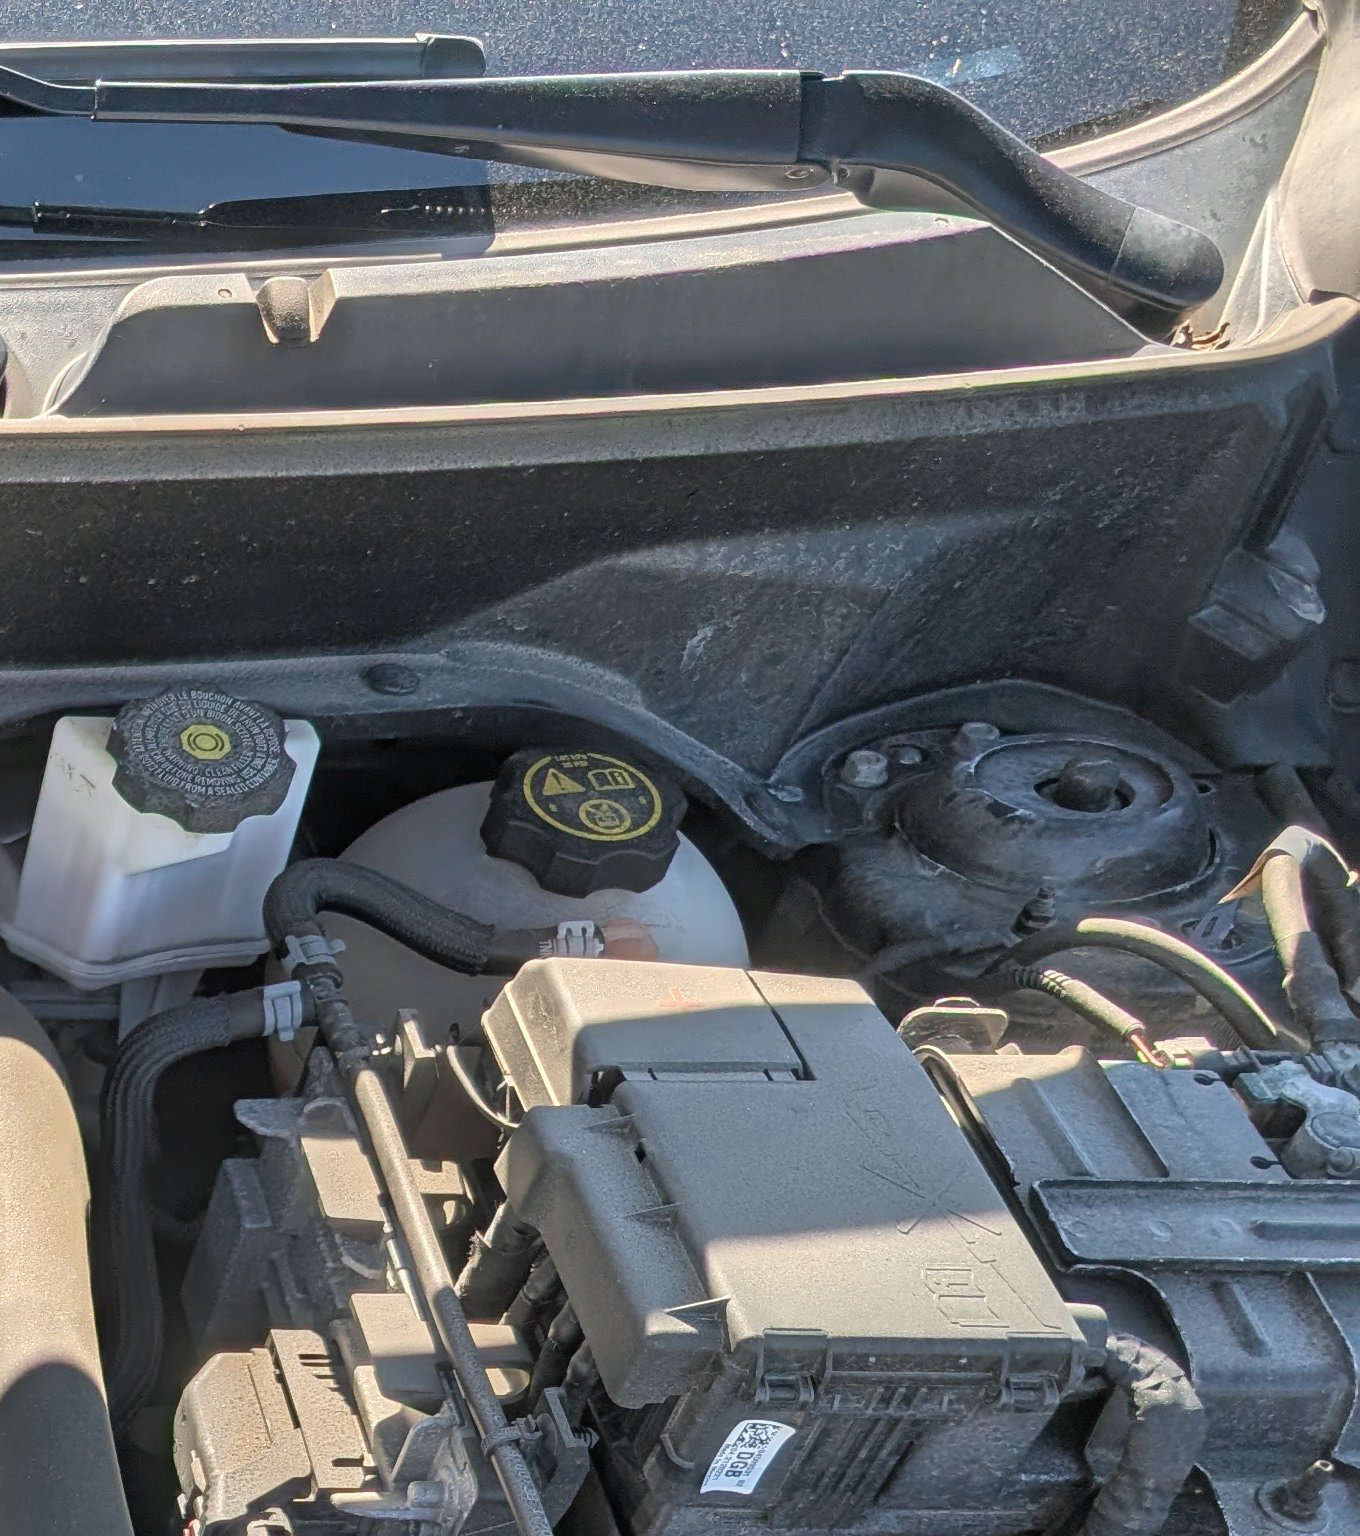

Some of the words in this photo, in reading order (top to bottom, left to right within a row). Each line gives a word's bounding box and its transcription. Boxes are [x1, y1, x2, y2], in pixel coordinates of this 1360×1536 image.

[177, 690, 189, 699] LE
[188, 689, 234, 706] BOUCHON
[231, 699, 260, 720] AVANT
[257, 717, 271, 729] LA
[191, 699, 227, 713] LIQUIDE
[225, 707, 241, 719] DE
[150, 749, 168, 763] CAP
[160, 760, 194, 782] BEFORE
[204, 766, 236, 777] CLEAN
[153, 766, 181, 785] FLUID
[178, 779, 205, 794] FROM
[206, 786, 214, 795] A
[214, 783, 251, 796] SEALED
[724, 1451, 755, 1478] DGB
